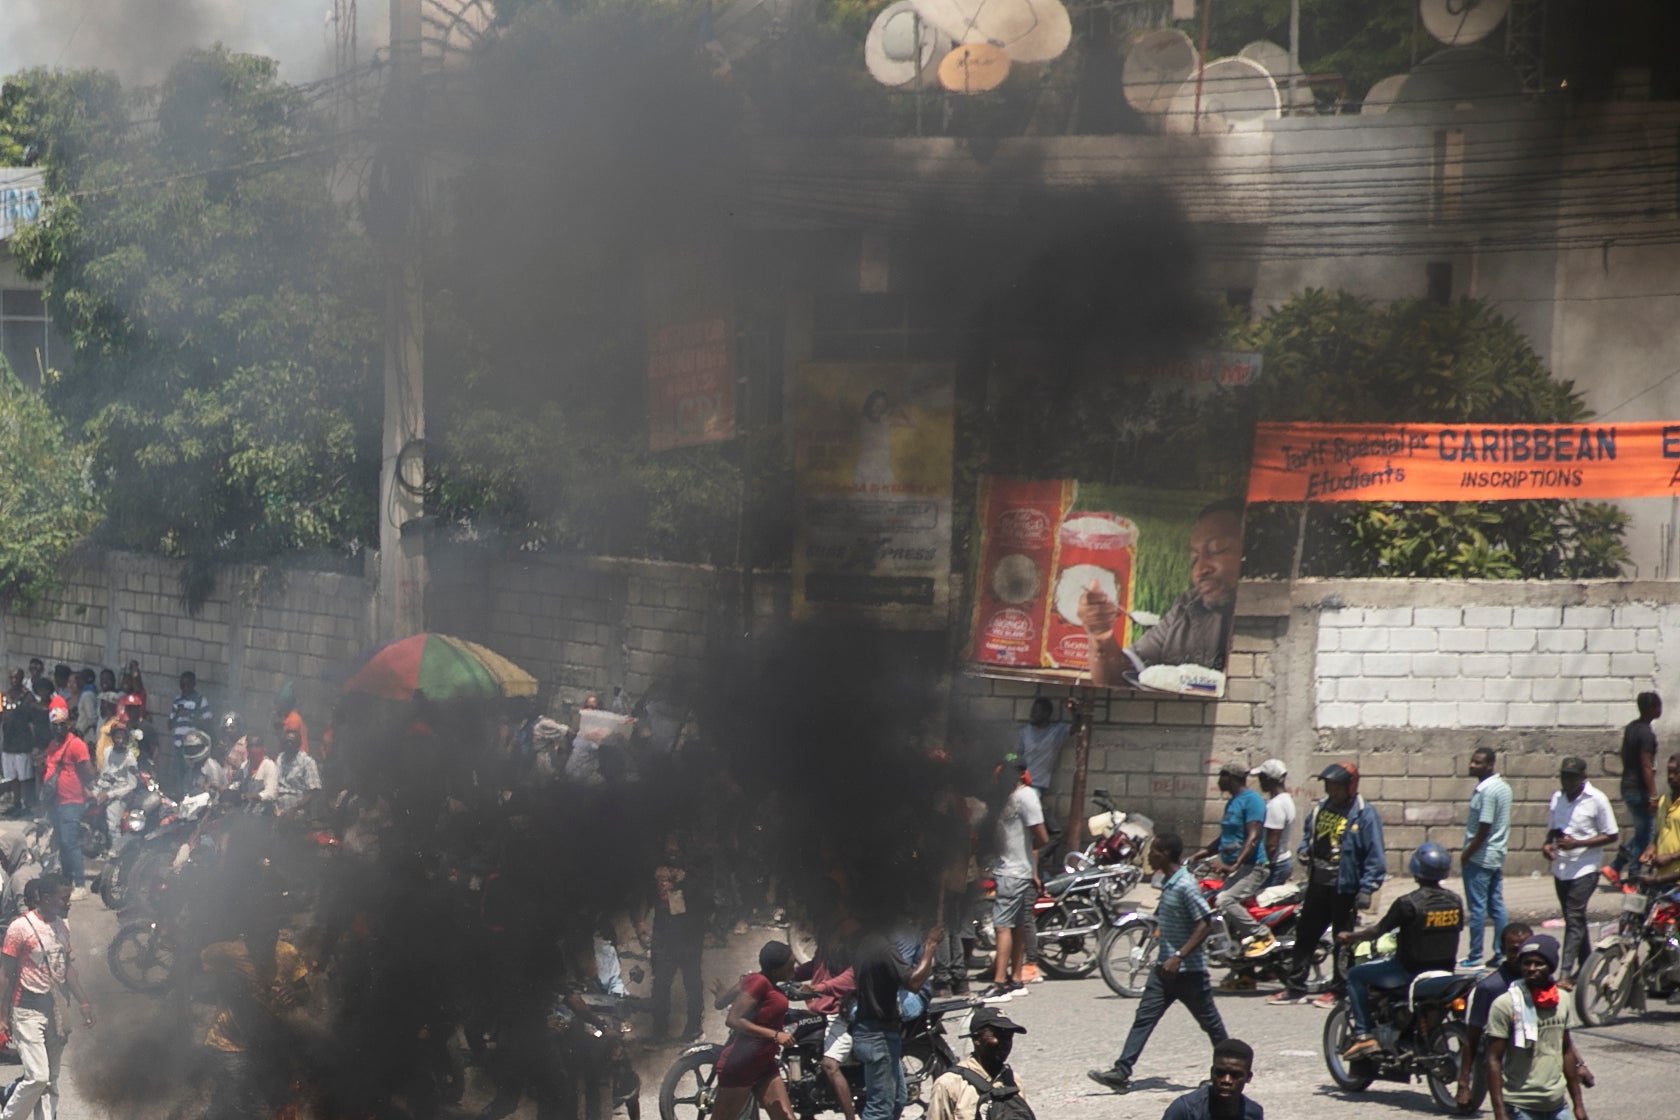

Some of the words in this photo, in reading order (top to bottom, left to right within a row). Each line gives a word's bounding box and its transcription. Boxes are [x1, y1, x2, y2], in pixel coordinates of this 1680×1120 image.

[1438, 426, 1617, 462] CARIBBEAN
[1460, 468, 1584, 488] INSCRIPTIONS
[1424, 908, 1460, 928] PRESS
